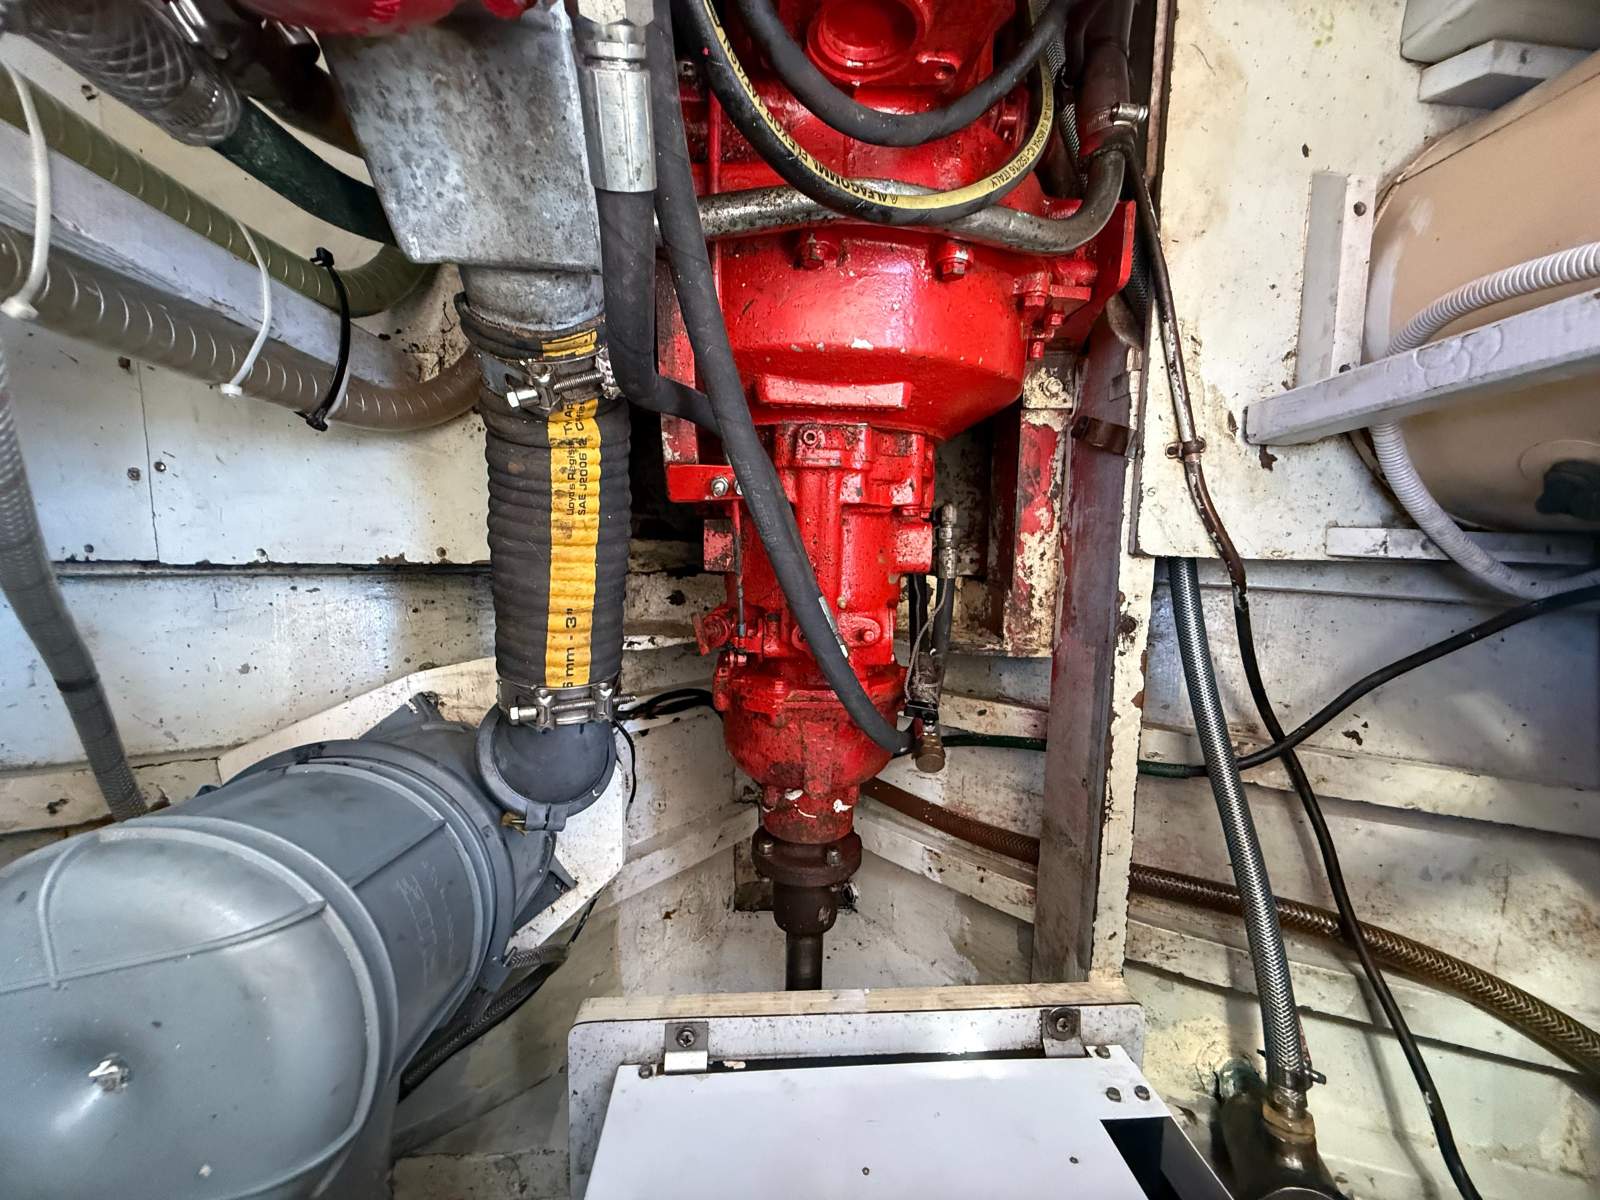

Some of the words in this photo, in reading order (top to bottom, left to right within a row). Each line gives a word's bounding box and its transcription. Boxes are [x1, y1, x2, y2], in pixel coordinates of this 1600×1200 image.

[991, 169, 1011, 189] ITALY
[579, 452, 588, 491] J2006
[578, 494, 587, 516] SAE
[566, 647, 575, 677] mm
